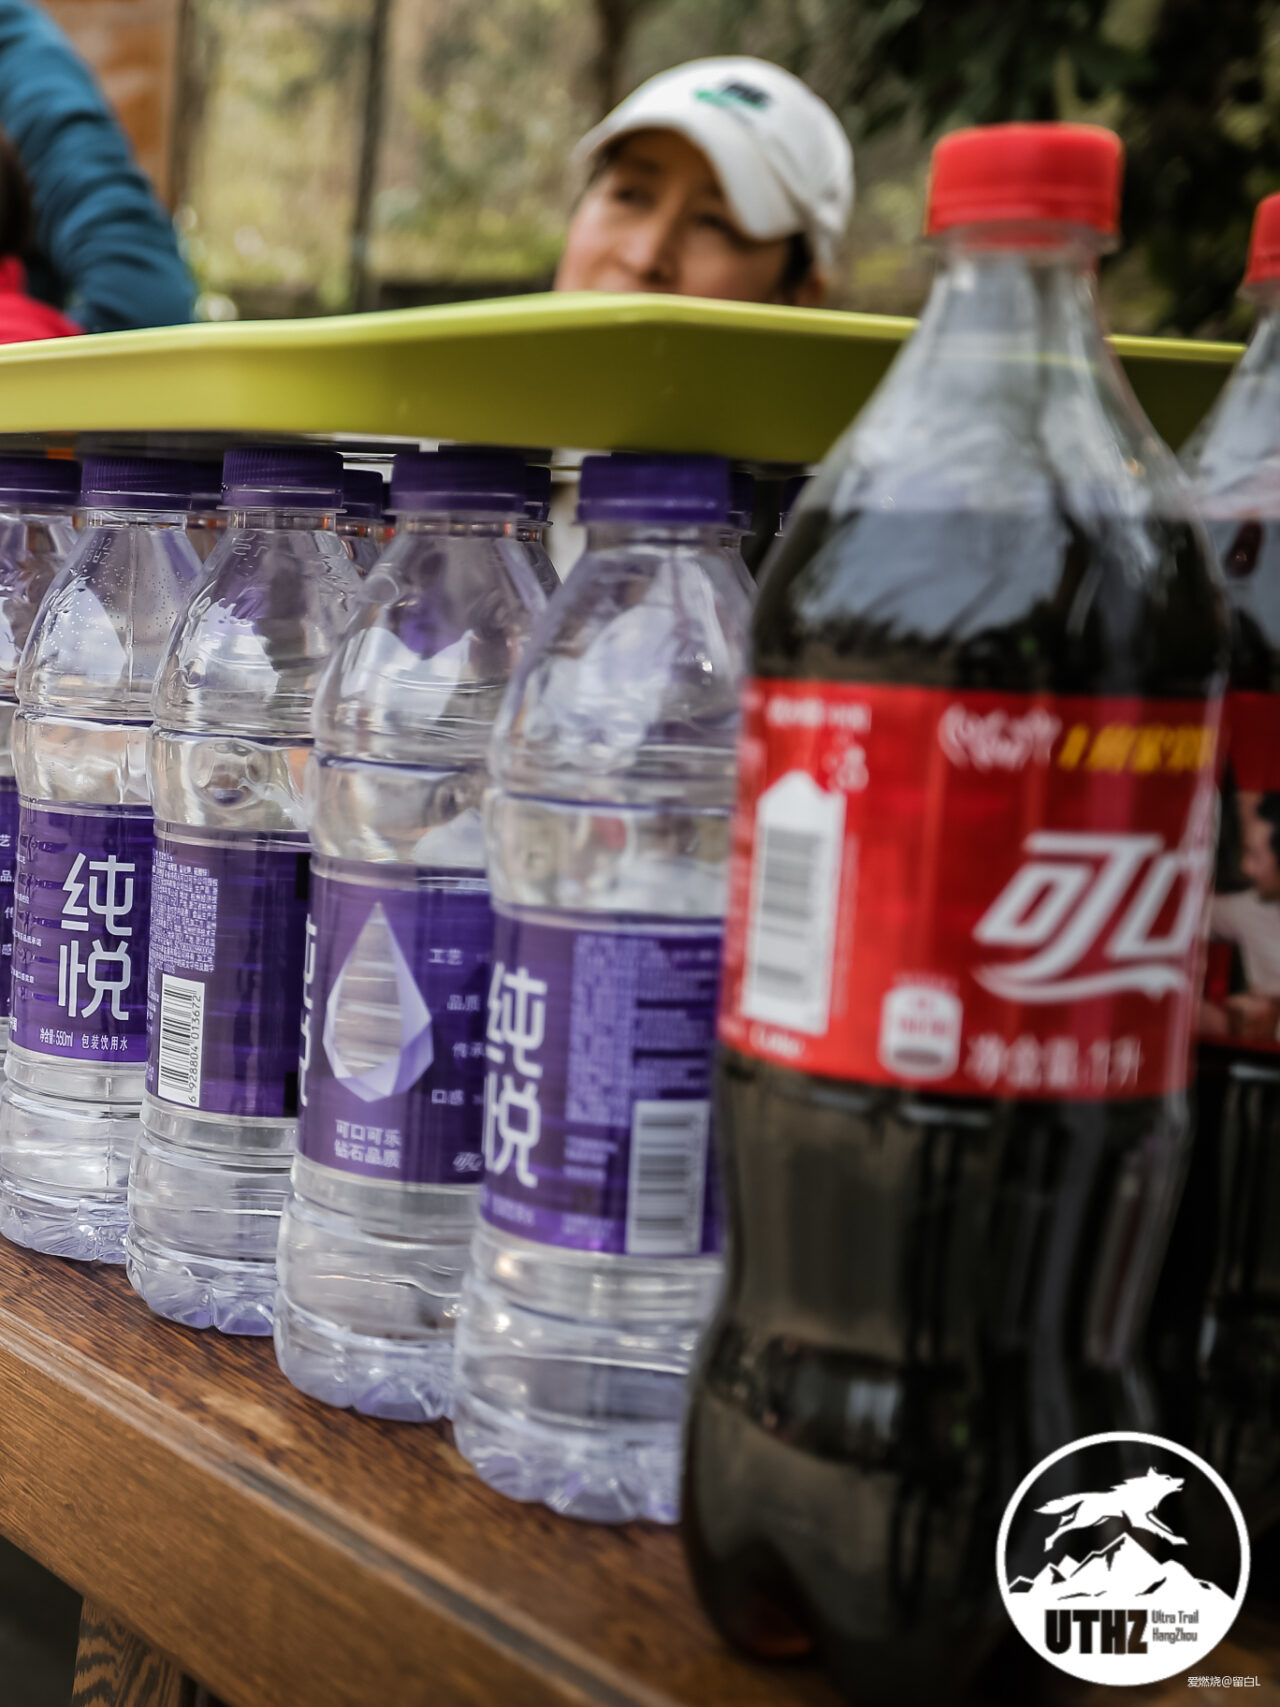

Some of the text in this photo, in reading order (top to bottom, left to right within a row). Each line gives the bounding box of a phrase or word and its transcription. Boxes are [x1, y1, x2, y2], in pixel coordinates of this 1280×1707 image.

[58, 852, 136, 1021] 纯悦
[428, 948, 463, 966] 工艺
[447, 993, 481, 1011] 品质
[82, 1033, 128, 1051] 包装饮用水
[431, 1088, 465, 1106] 口感
[335, 1118, 402, 1148] 可口可乐
[333, 1138, 401, 1169] 钻石品质
